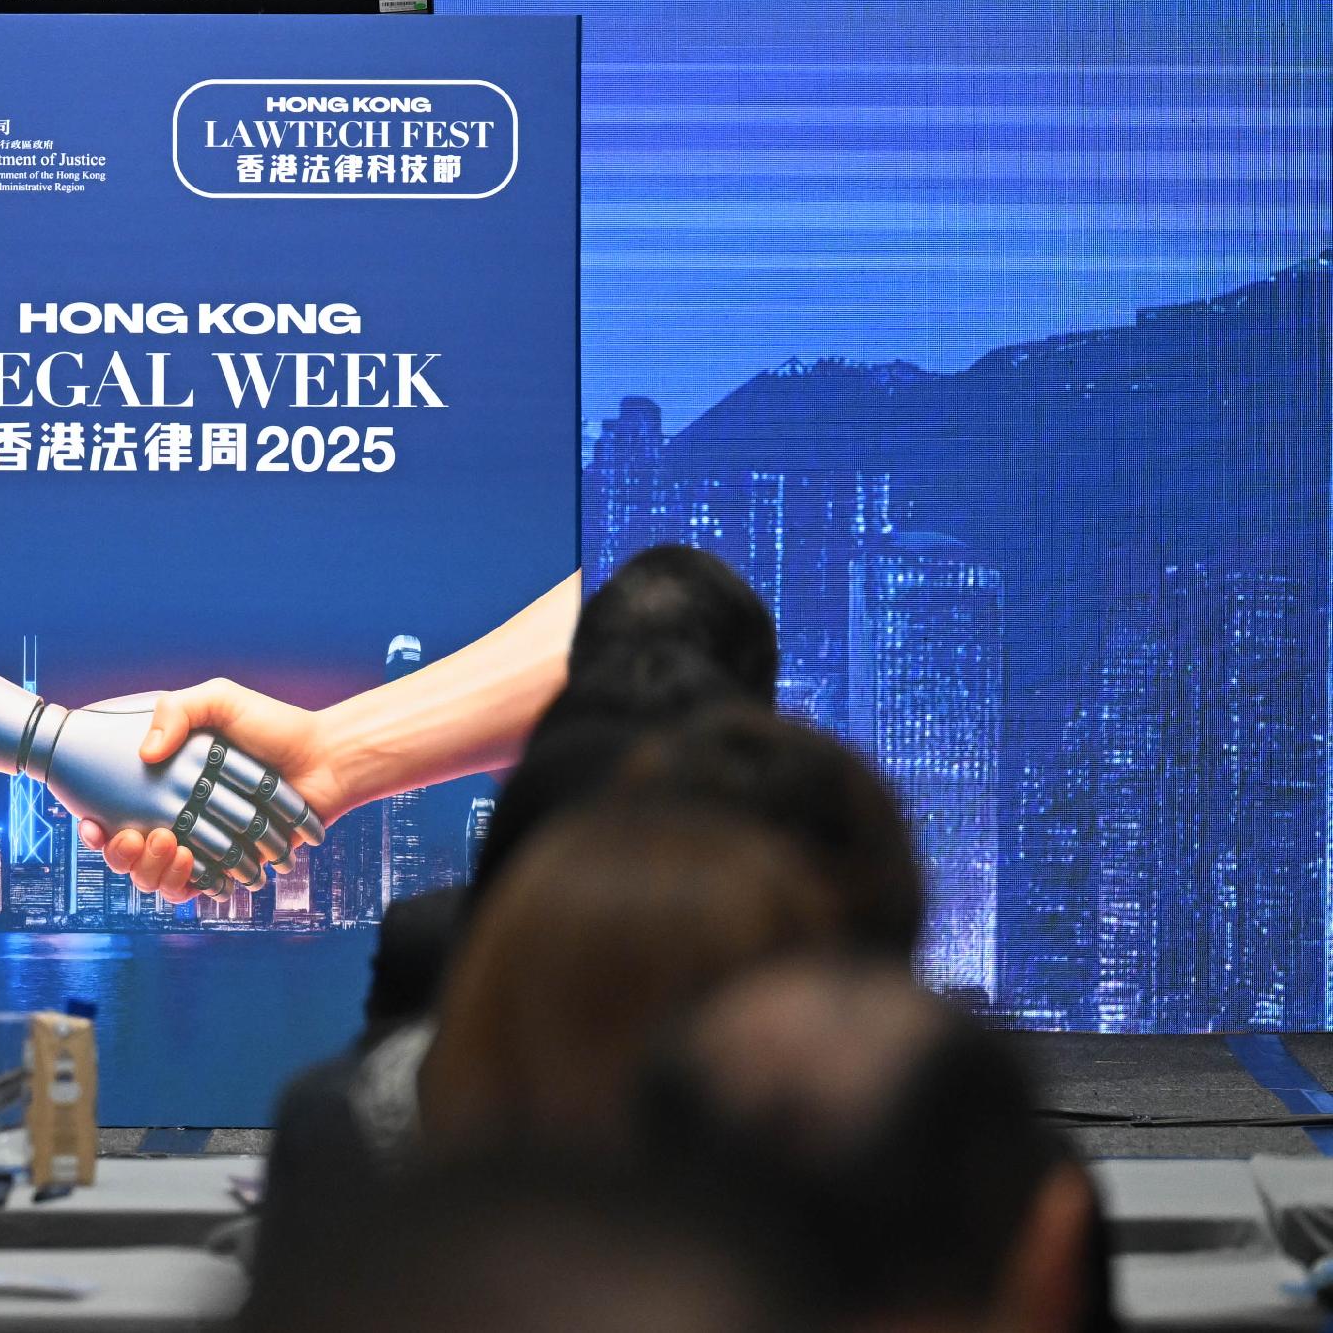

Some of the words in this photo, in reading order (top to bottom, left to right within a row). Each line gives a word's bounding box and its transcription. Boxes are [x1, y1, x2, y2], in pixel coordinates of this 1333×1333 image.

[267, 97, 348, 112] HONG
[353, 97, 431, 112] KONG
[206, 120, 389, 148] LAWTECH
[403, 121, 494, 148] FEST
[40, 152, 57, 166] of
[58, 152, 106, 167] Justice
[237, 155, 461, 183] 香港法律科技節
[28, 171, 39, 180] of
[40, 171, 54, 180] the
[56, 170, 80, 181] Hong
[82, 170, 106, 182] Kong
[54, 182, 84, 194] Region
[20, 302, 188, 334] HONG
[199, 303, 360, 334] KONG
[213, 353, 447, 408] WEEK
